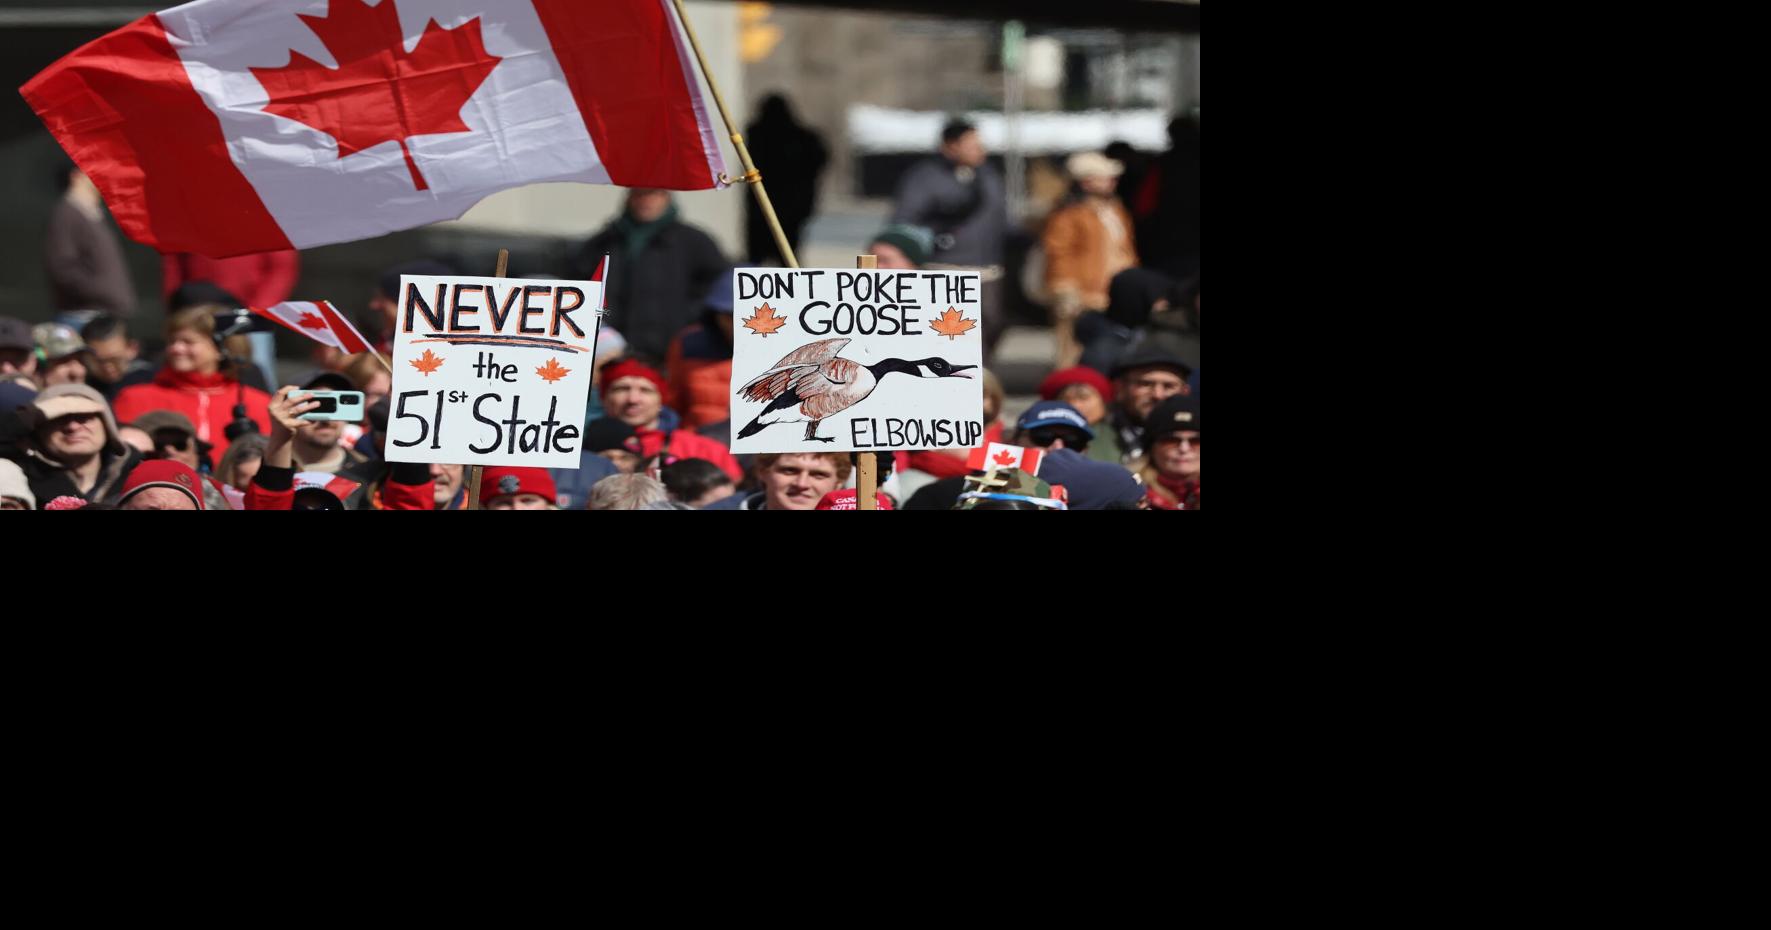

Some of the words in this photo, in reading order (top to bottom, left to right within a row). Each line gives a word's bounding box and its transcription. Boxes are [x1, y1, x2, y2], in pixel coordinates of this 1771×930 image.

[738, 271, 825, 299] DON'T
[837, 272, 917, 303] POKE
[922, 274, 979, 304] THE
[403, 282, 586, 338] NEVER
[799, 301, 922, 336] GOOSE
[473, 352, 518, 382] the
[393, 390, 468, 449] 51st
[469, 393, 579, 454] State
[851, 418, 953, 447] ELBOWS
[955, 421, 981, 446] UP
